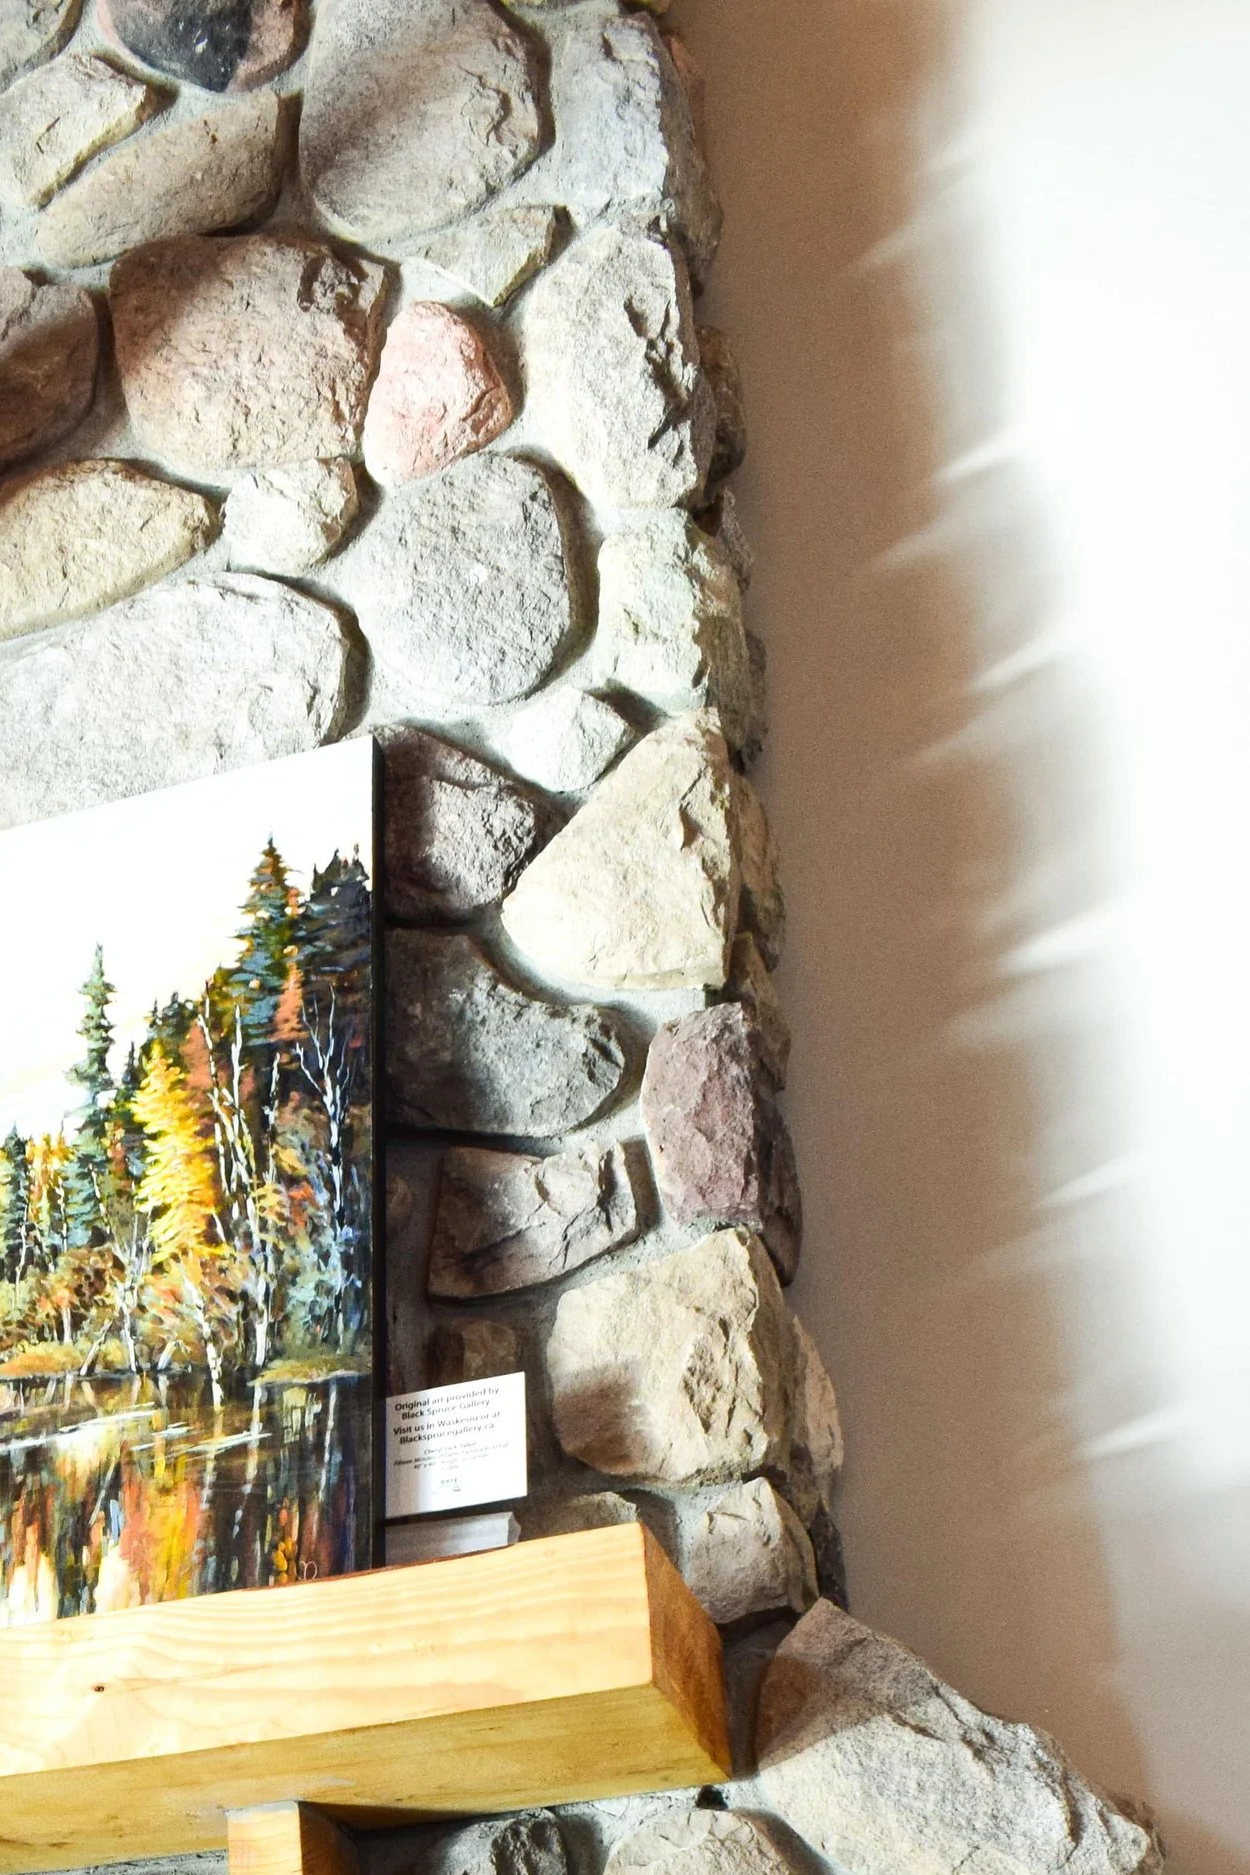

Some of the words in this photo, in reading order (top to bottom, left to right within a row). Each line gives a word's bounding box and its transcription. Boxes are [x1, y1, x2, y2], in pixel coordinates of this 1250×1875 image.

[395, 1399, 430, 1411] Original
[431, 1396, 444, 1405] art
[446, 1387, 486, 1403] provided
[488, 1386, 500, 1397] by
[401, 1408, 425, 1420] Black
[426, 1404, 458, 1416] Spruce
[459, 1399, 491, 1411] Gallery
[393, 1424, 413, 1436] Visit
[414, 1423, 425, 1432] us
[426, 1421, 435, 1430] in
[491, 1411, 501, 1419] at
[399, 1422, 495, 1445] Blacksprucegallery.ca
